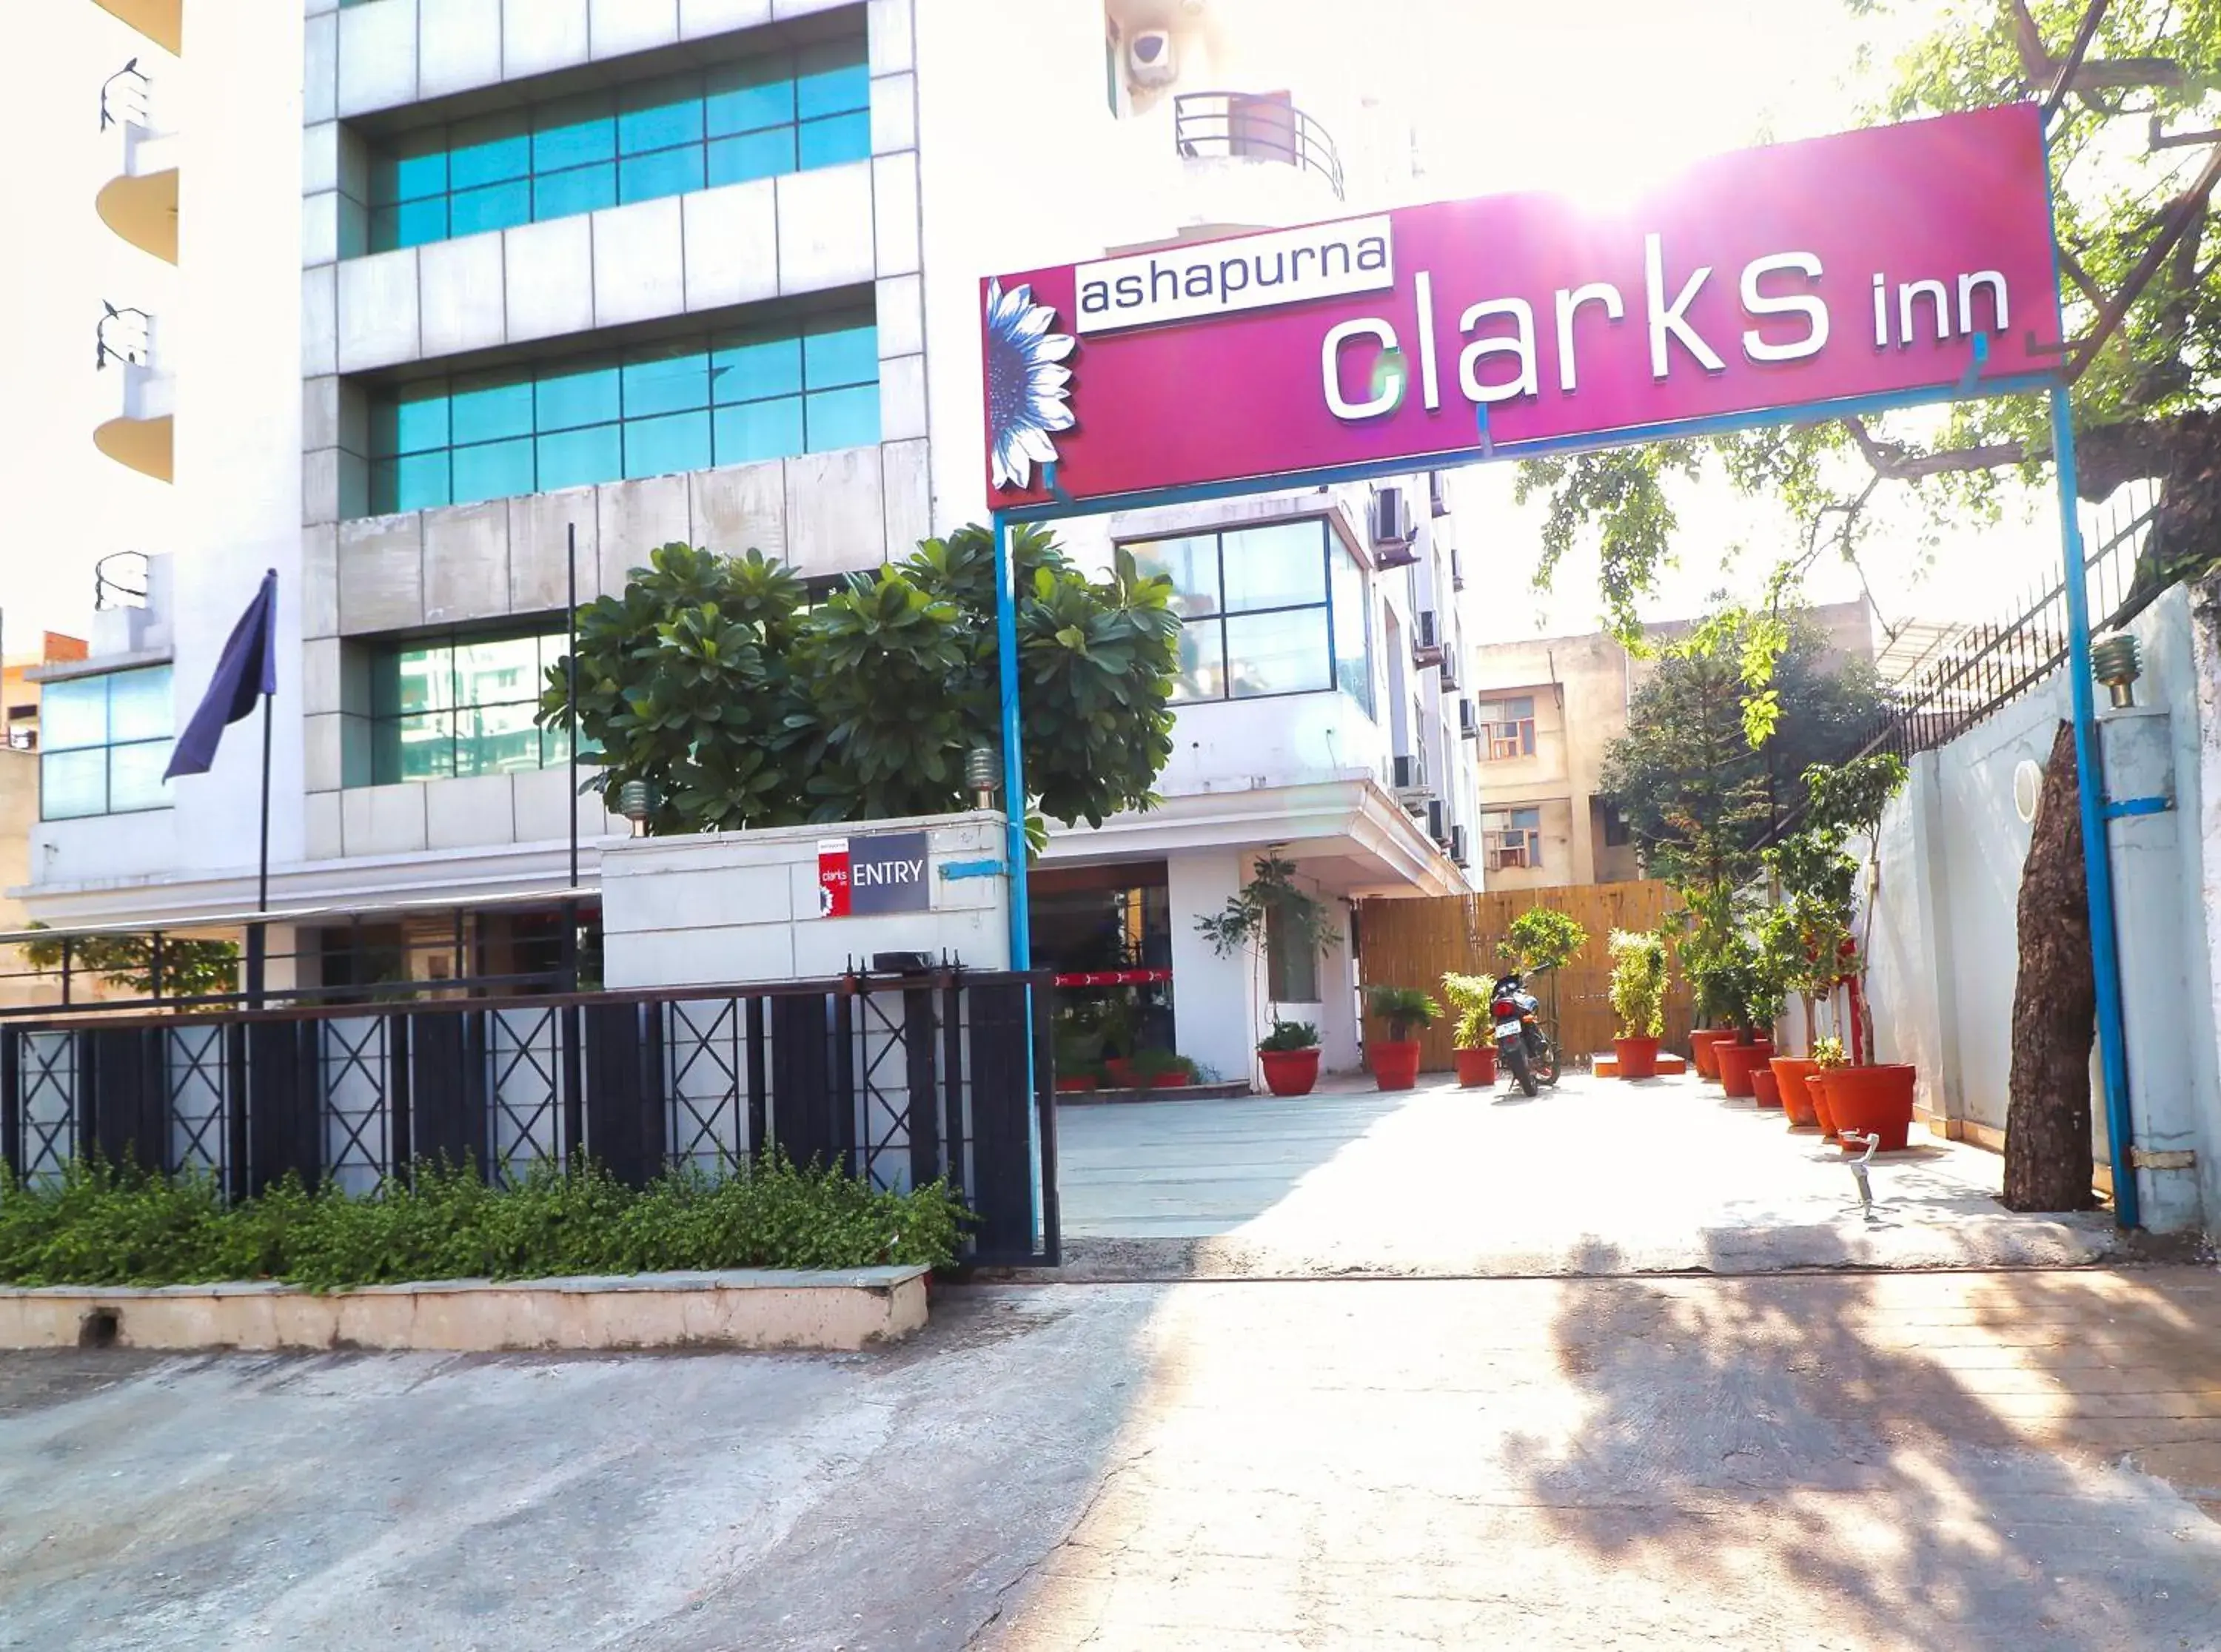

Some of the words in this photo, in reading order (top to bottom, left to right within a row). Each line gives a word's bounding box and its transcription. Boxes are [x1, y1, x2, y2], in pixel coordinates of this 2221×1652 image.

[1081, 235, 1388, 314] ashapurna
[1321, 232, 1829, 421] clarks
[1872, 269, 2010, 347] inn
[853, 859, 923, 887] ENTRY
